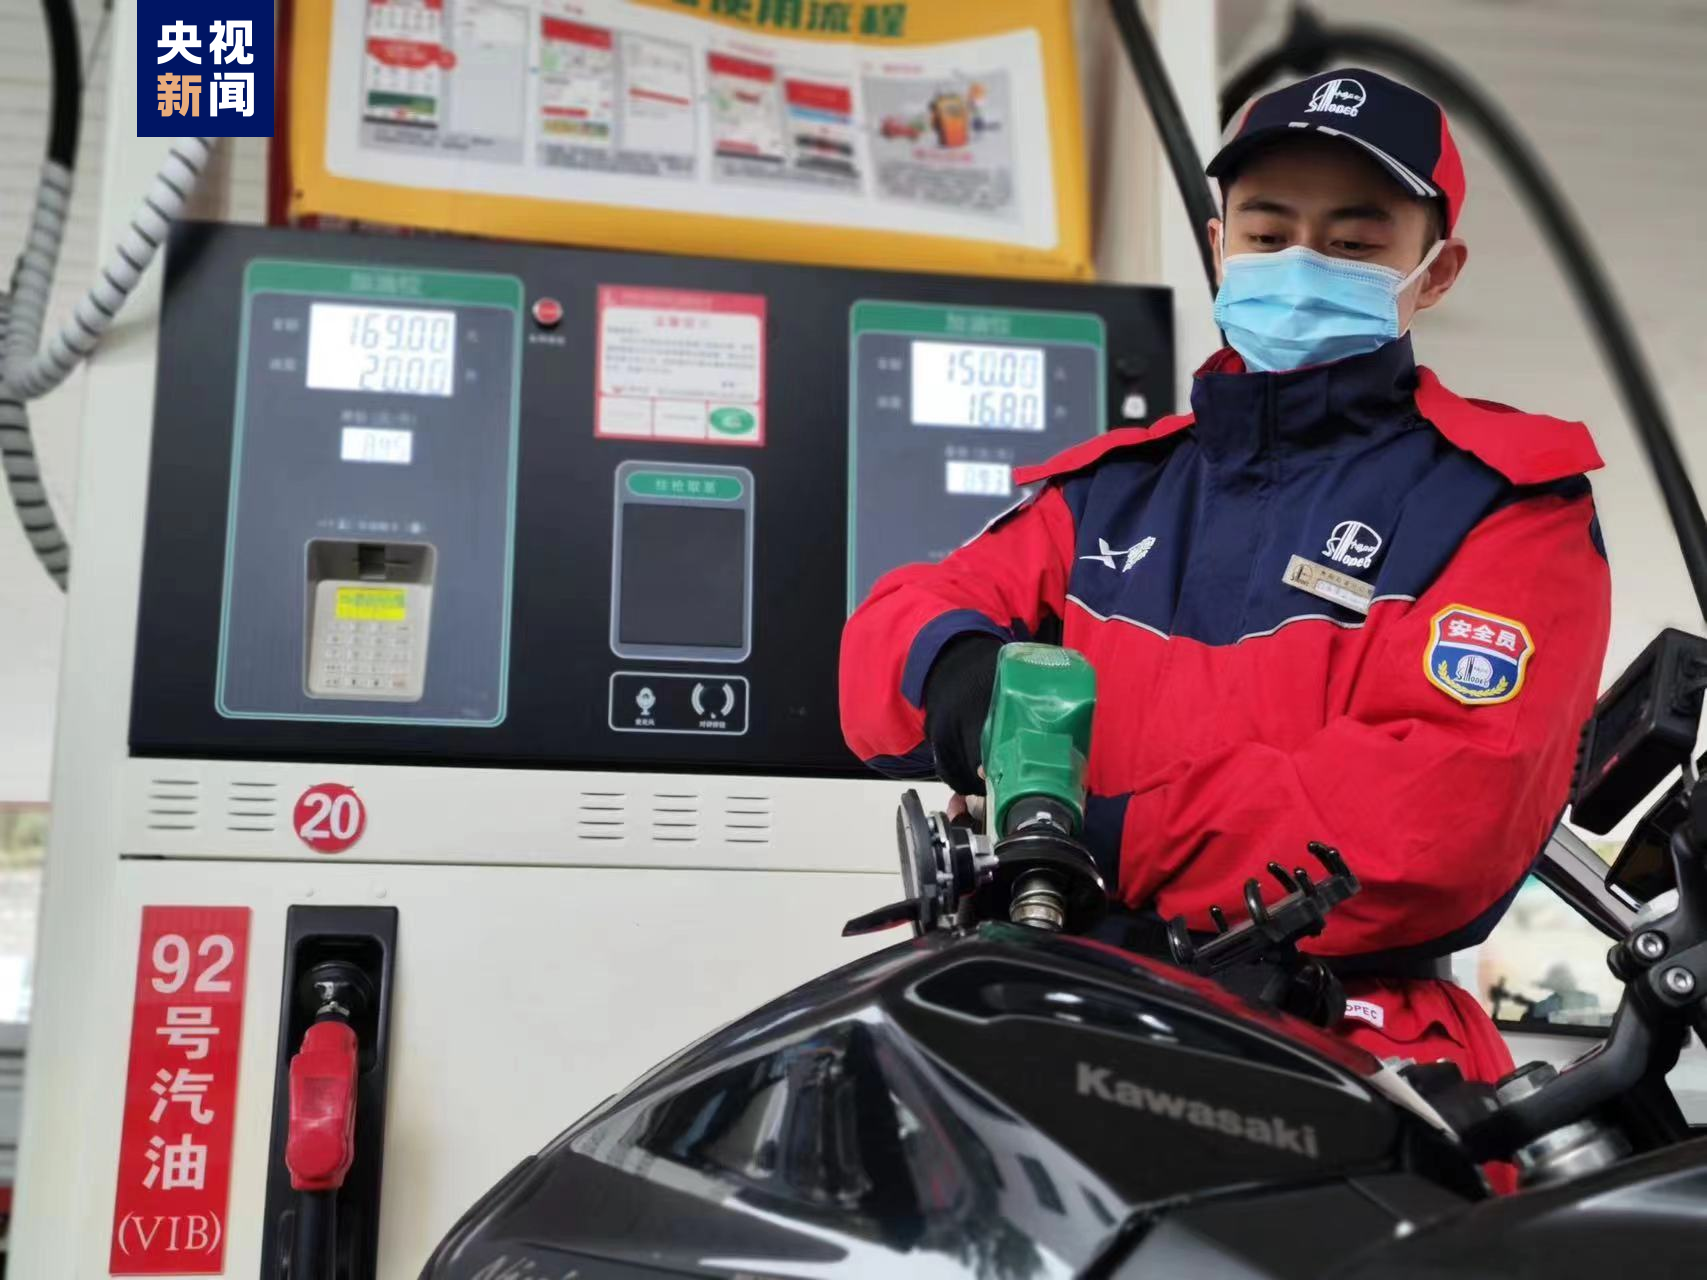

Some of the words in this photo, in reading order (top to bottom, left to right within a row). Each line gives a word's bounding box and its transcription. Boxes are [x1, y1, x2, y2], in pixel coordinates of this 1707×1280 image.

[670, 0, 907, 37] 使用流程
[1447, 619, 1517, 652] 安全员
[300, 792, 360, 840] 20
[151, 934, 235, 994] 92
[1076, 1061, 1319, 1159] Kawasaki
[118, 1210, 222, 1256] (VIB)
